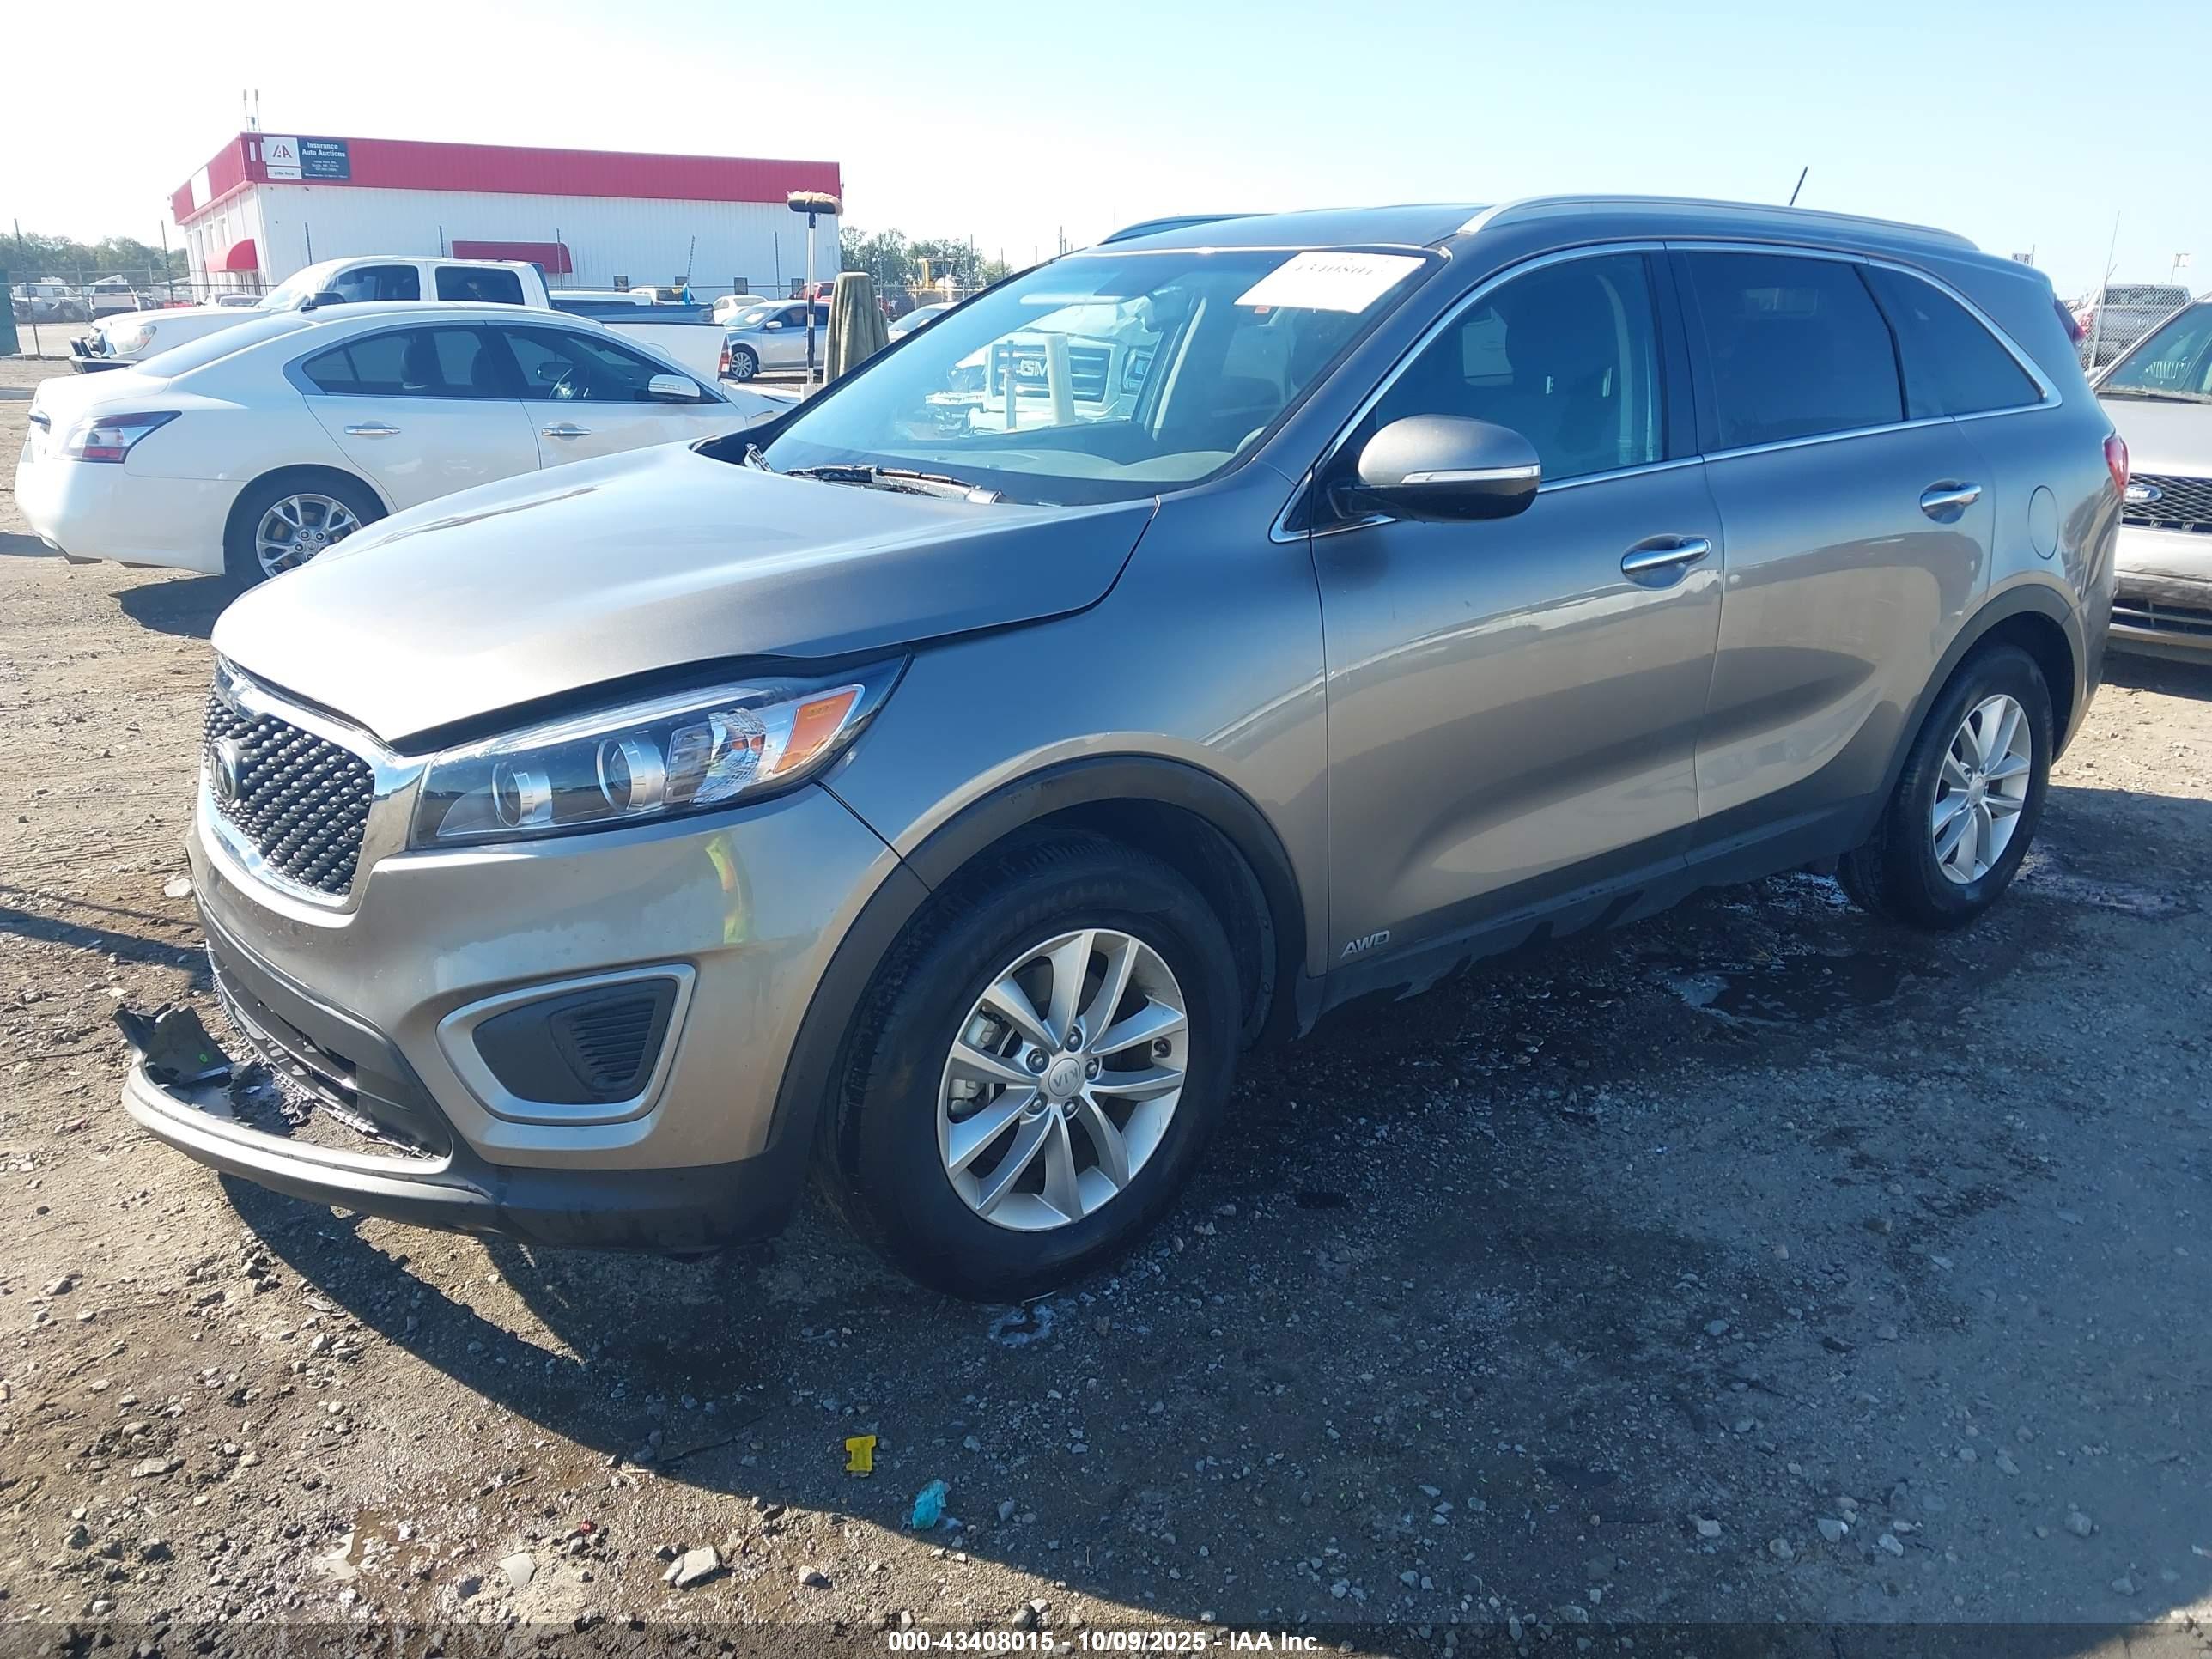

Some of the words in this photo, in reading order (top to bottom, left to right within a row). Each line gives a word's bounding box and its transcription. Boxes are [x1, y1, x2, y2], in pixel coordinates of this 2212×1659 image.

[1020, 359, 1048, 377] GM
[1340, 930, 1390, 959] AWD
[1053, 1066, 1079, 1087] KIA
